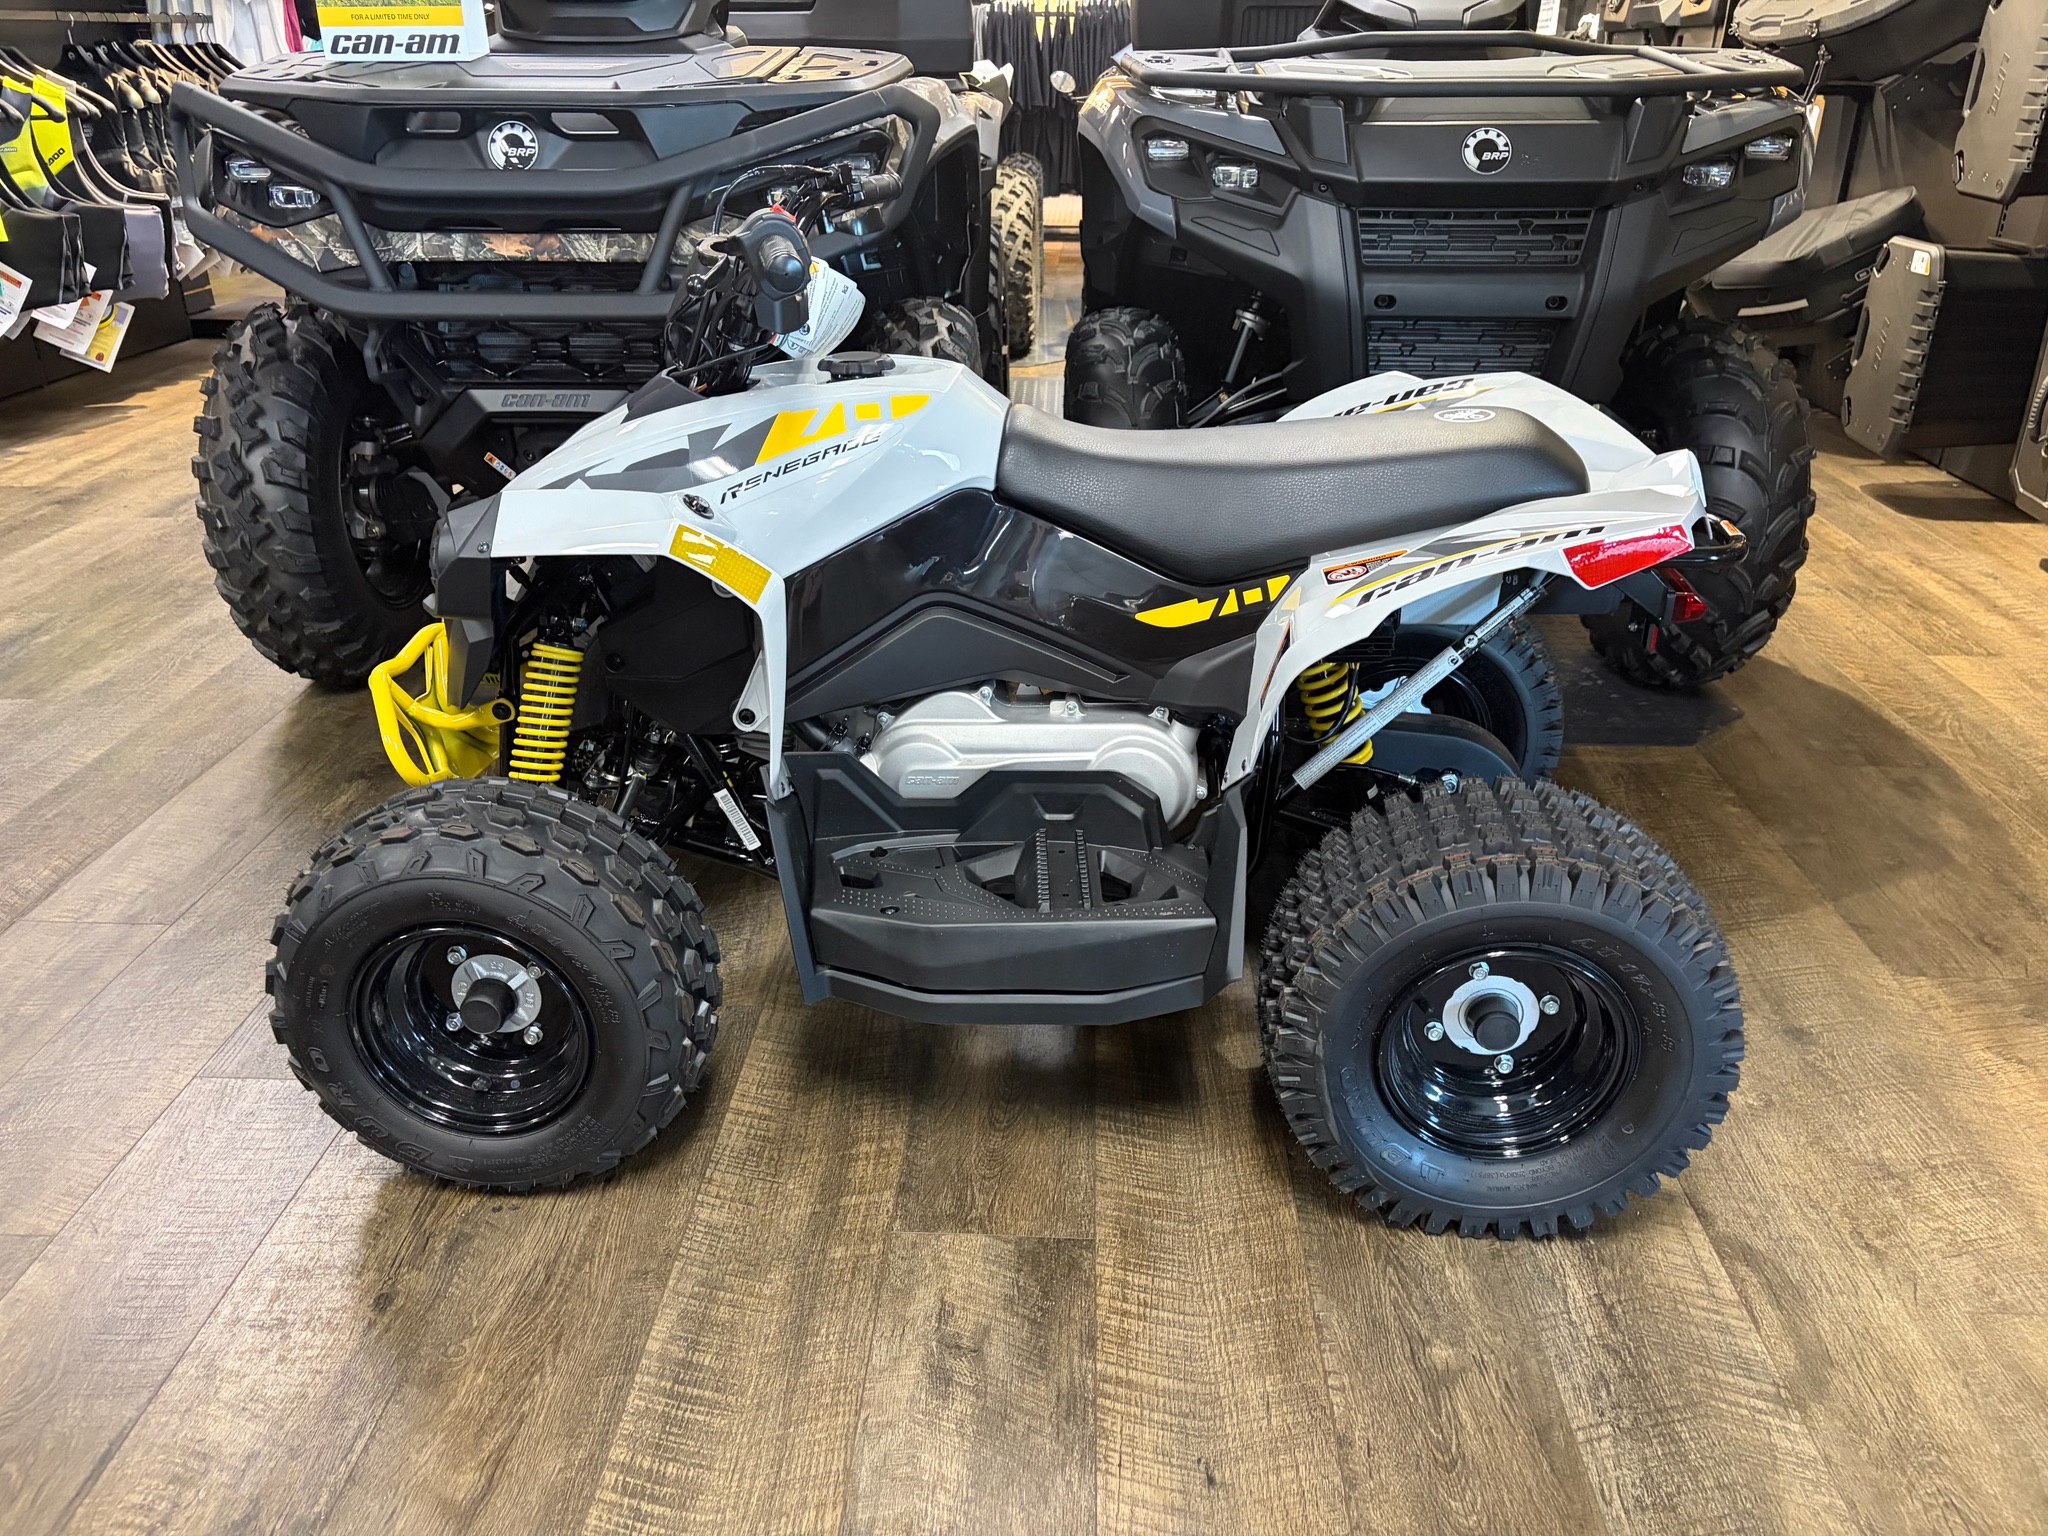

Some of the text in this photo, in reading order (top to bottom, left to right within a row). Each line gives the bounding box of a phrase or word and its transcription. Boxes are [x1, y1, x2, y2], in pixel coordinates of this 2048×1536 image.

[330, 34, 460, 54] can-am
[508, 148, 536, 156] BRP
[1481, 152, 1509, 160] BRP
[501, 393, 591, 408] can-am
[720, 432, 882, 505] RENEGADE
[1355, 526, 1607, 608] can-am
[905, 776, 960, 785] can-am
